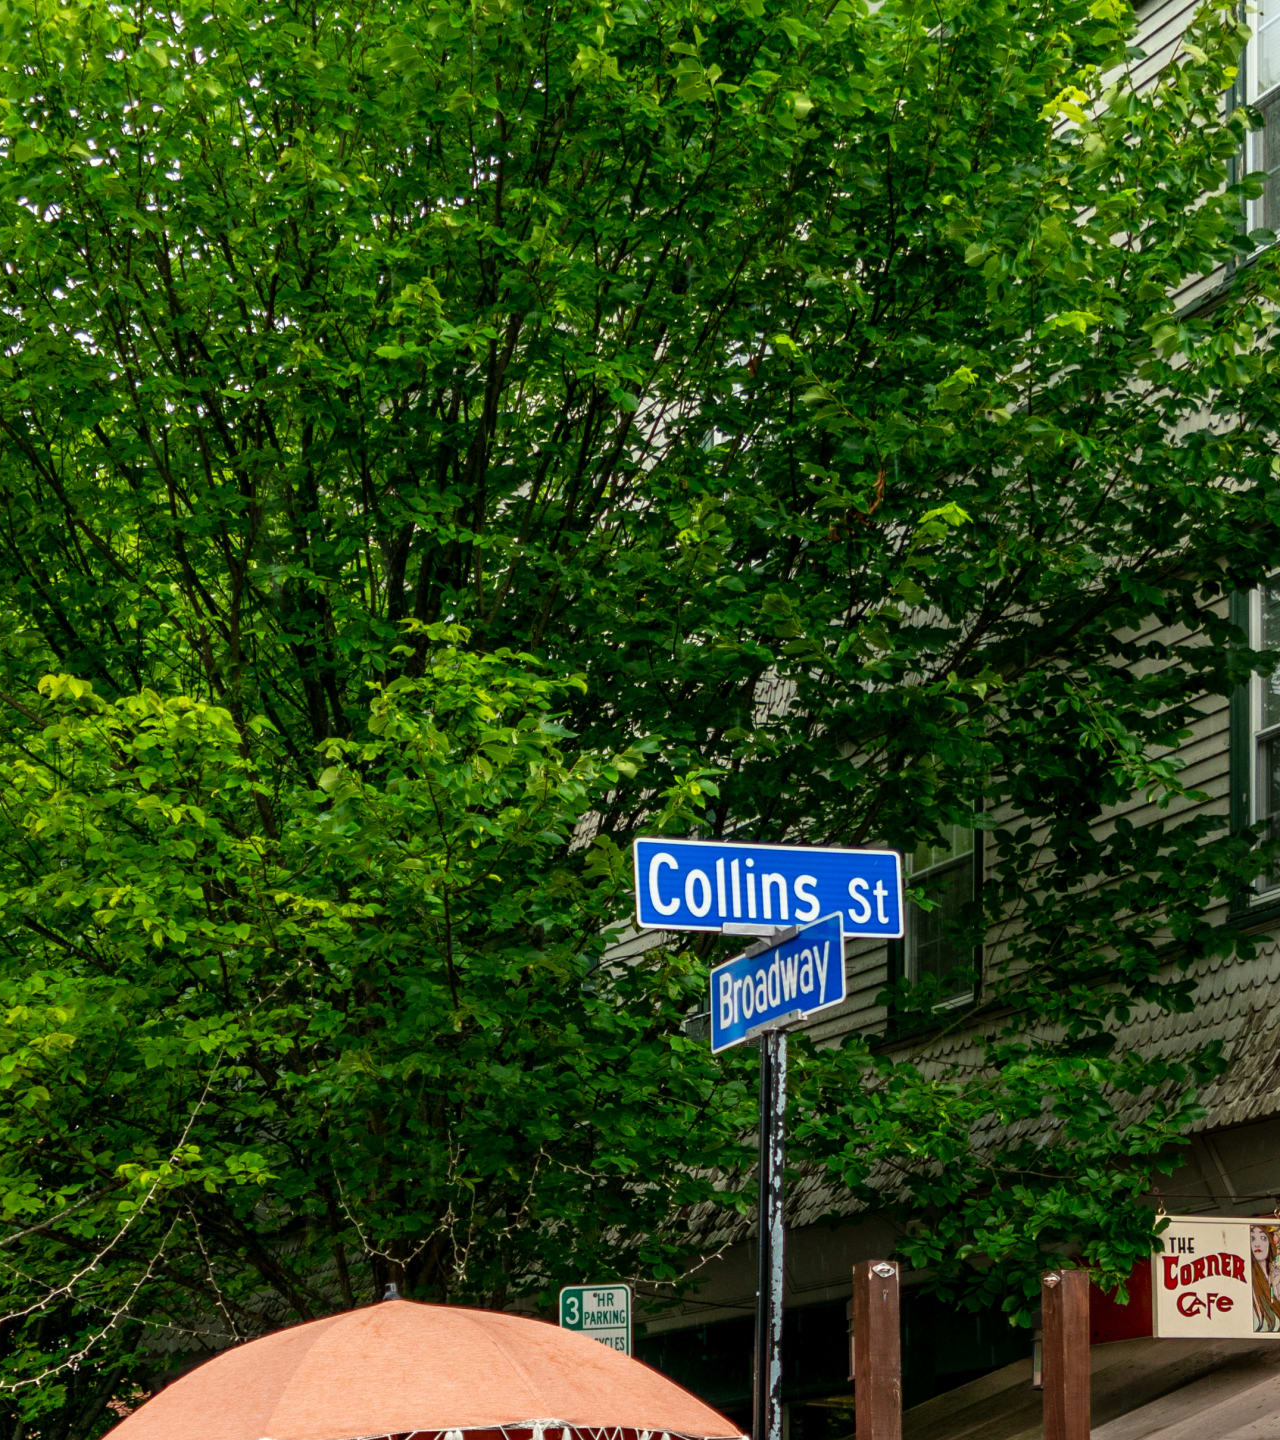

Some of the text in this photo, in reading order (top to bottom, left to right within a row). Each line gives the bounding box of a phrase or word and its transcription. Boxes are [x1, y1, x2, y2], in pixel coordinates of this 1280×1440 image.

[648, 852, 889, 924] Collins St
[719, 941, 830, 1031] Broadway
[1169, 1237, 1195, 1253] THE
[565, 1296, 580, 1325] 3
[596, 1293, 614, 1307] HR
[583, 1310, 626, 1325] PARKING
